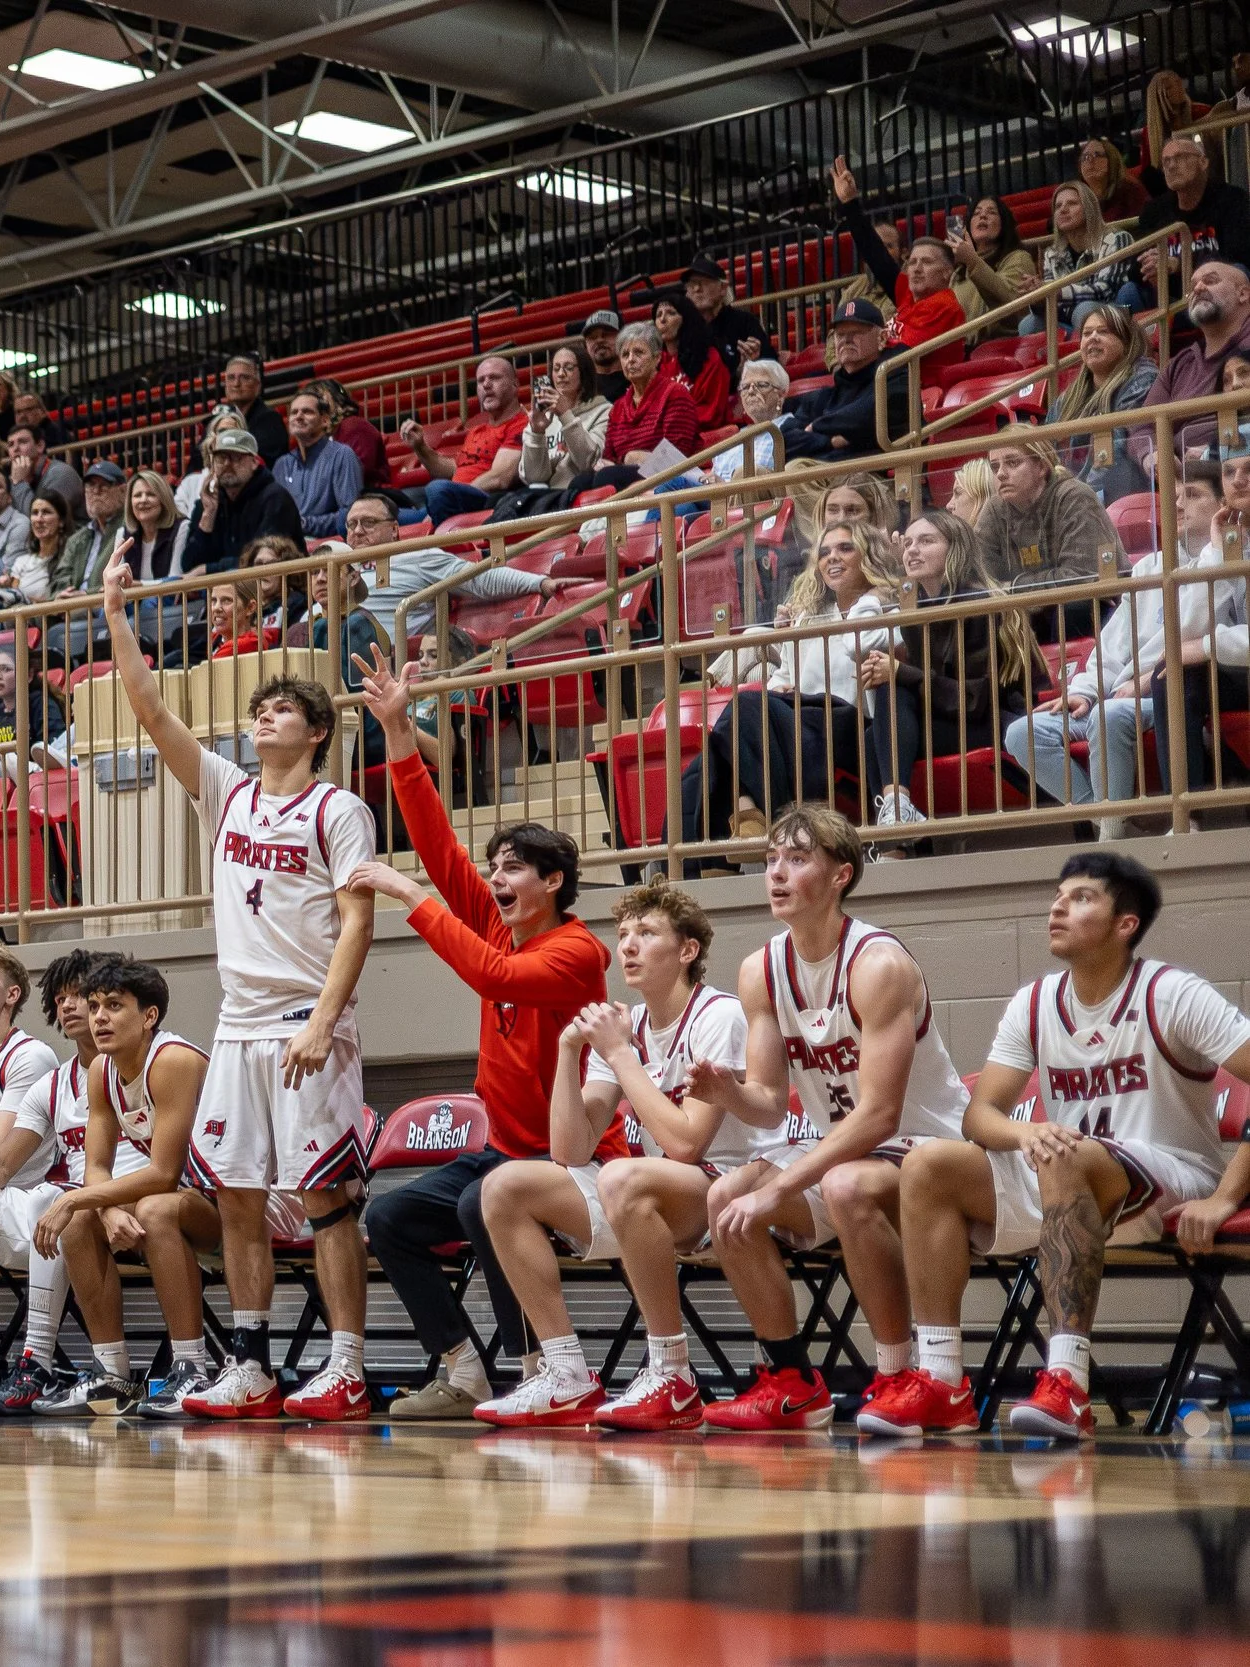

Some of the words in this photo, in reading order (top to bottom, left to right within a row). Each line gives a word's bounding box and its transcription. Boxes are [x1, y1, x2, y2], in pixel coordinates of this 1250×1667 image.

[223, 830, 309, 876] PIRATES
[246, 878, 264, 916] 4
[1047, 1052, 1149, 1103] PIRATES
[406, 1119, 472, 1150] BRANSON
